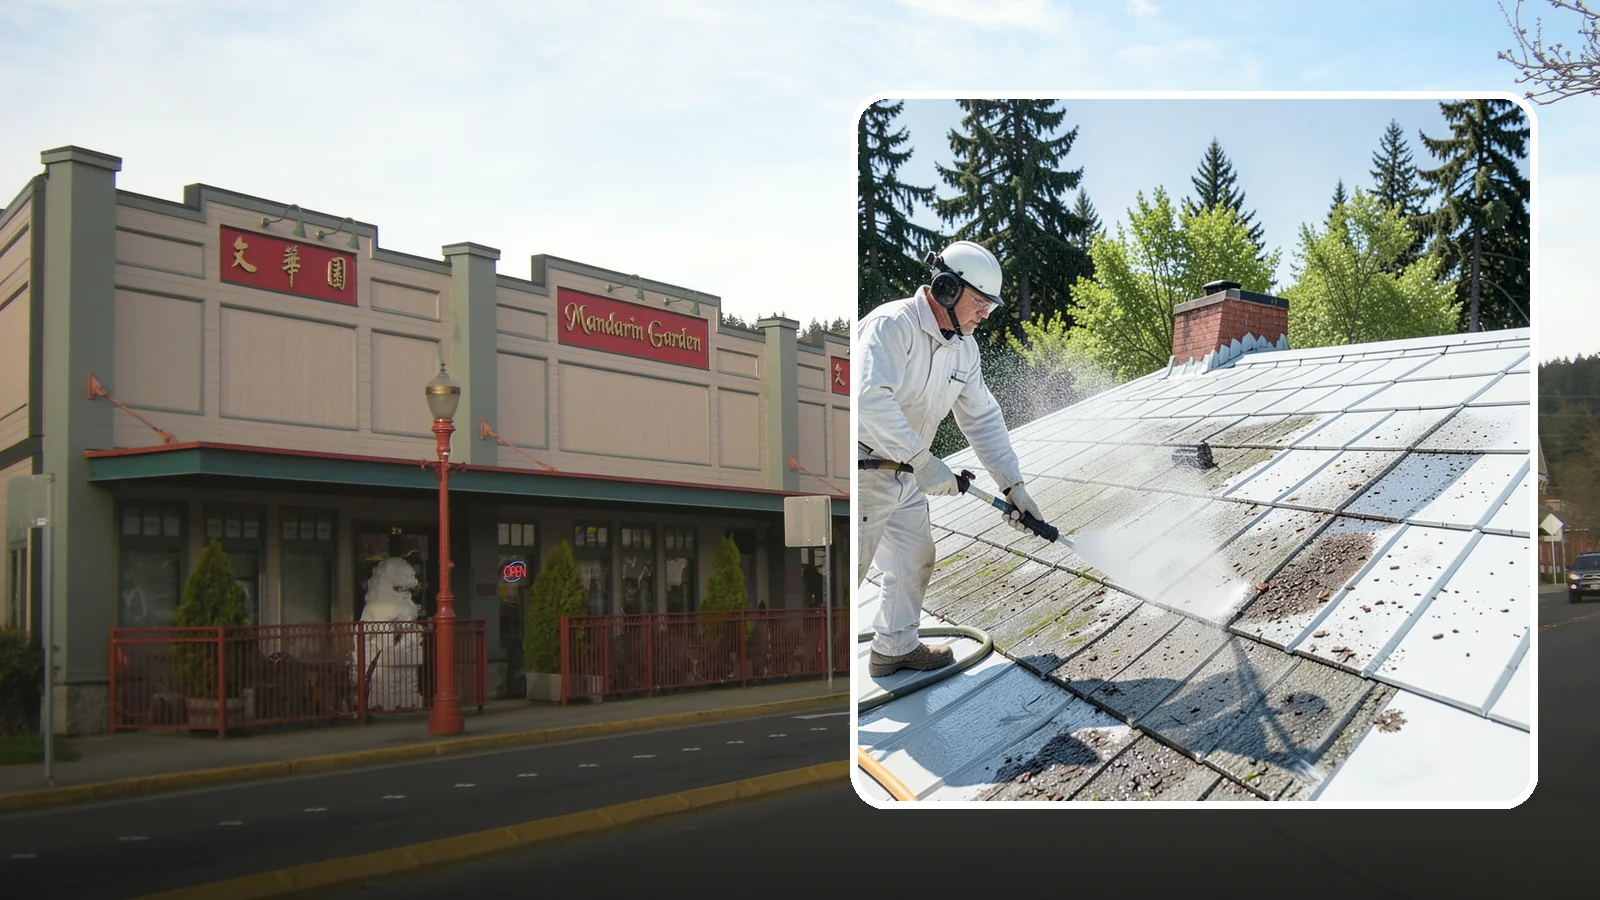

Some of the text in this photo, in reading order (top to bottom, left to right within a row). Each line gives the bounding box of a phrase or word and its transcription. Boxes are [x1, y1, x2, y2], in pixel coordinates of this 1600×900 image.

[230, 235, 346, 291] 文華園
[564, 302, 702, 352] Mandarin Garden
[503, 565, 527, 578] OPEN
